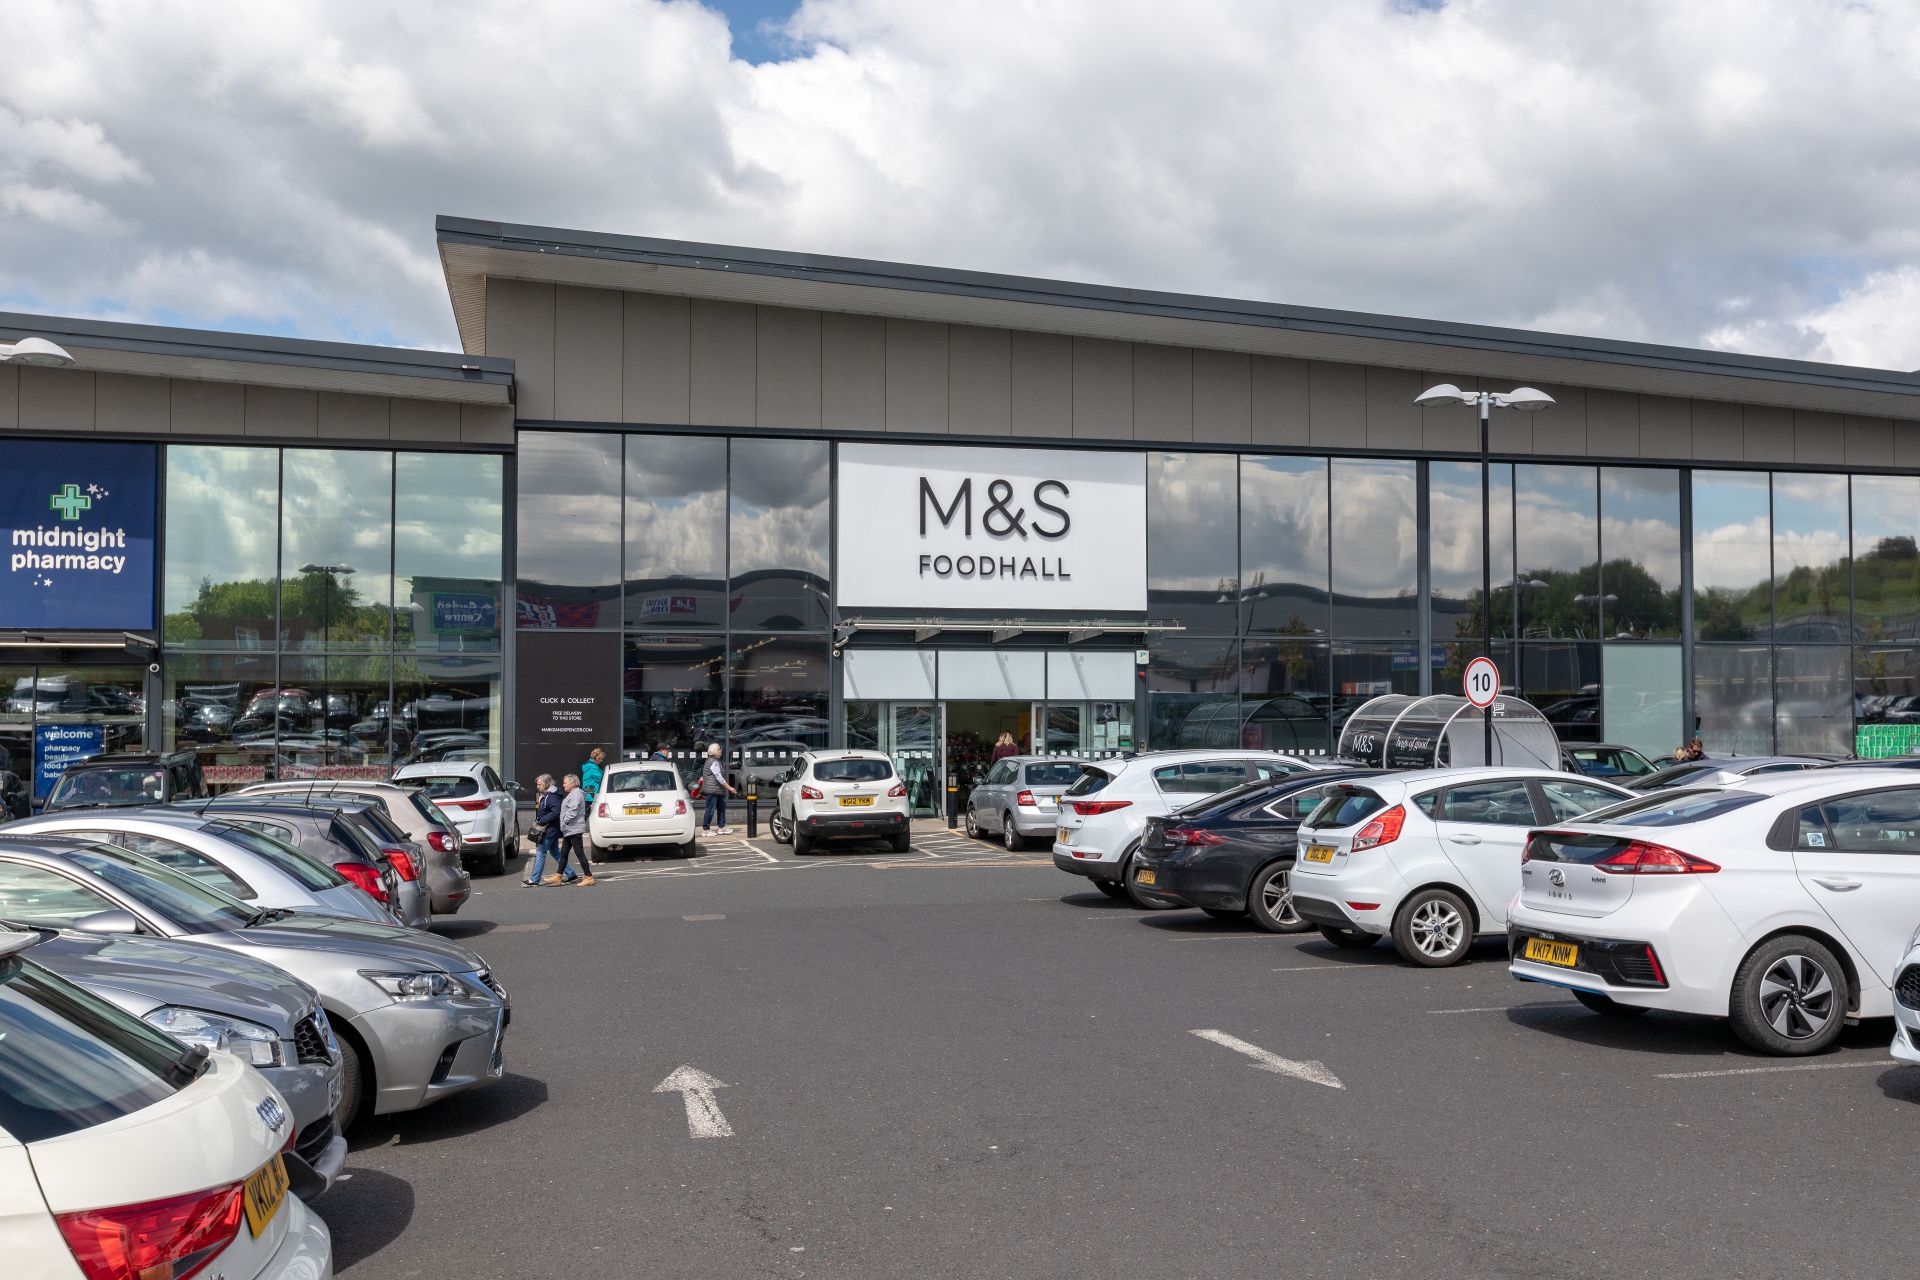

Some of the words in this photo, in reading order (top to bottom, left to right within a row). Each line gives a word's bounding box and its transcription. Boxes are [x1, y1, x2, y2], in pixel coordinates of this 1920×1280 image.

[919, 476, 1071, 538] M&S
[12, 525, 126, 552] midnight
[11, 549, 126, 574] pharmacy
[919, 554, 1071, 578] FOODHALL
[1472, 673, 1491, 692] 10
[44, 729, 94, 739] welcome
[44, 745, 81, 753] pharmacy
[1352, 735, 1375, 753] M&S
[44, 754, 69, 762] beauty
[1532, 941, 1552, 959] VK17
[249, 1167, 276, 1222] VK12
